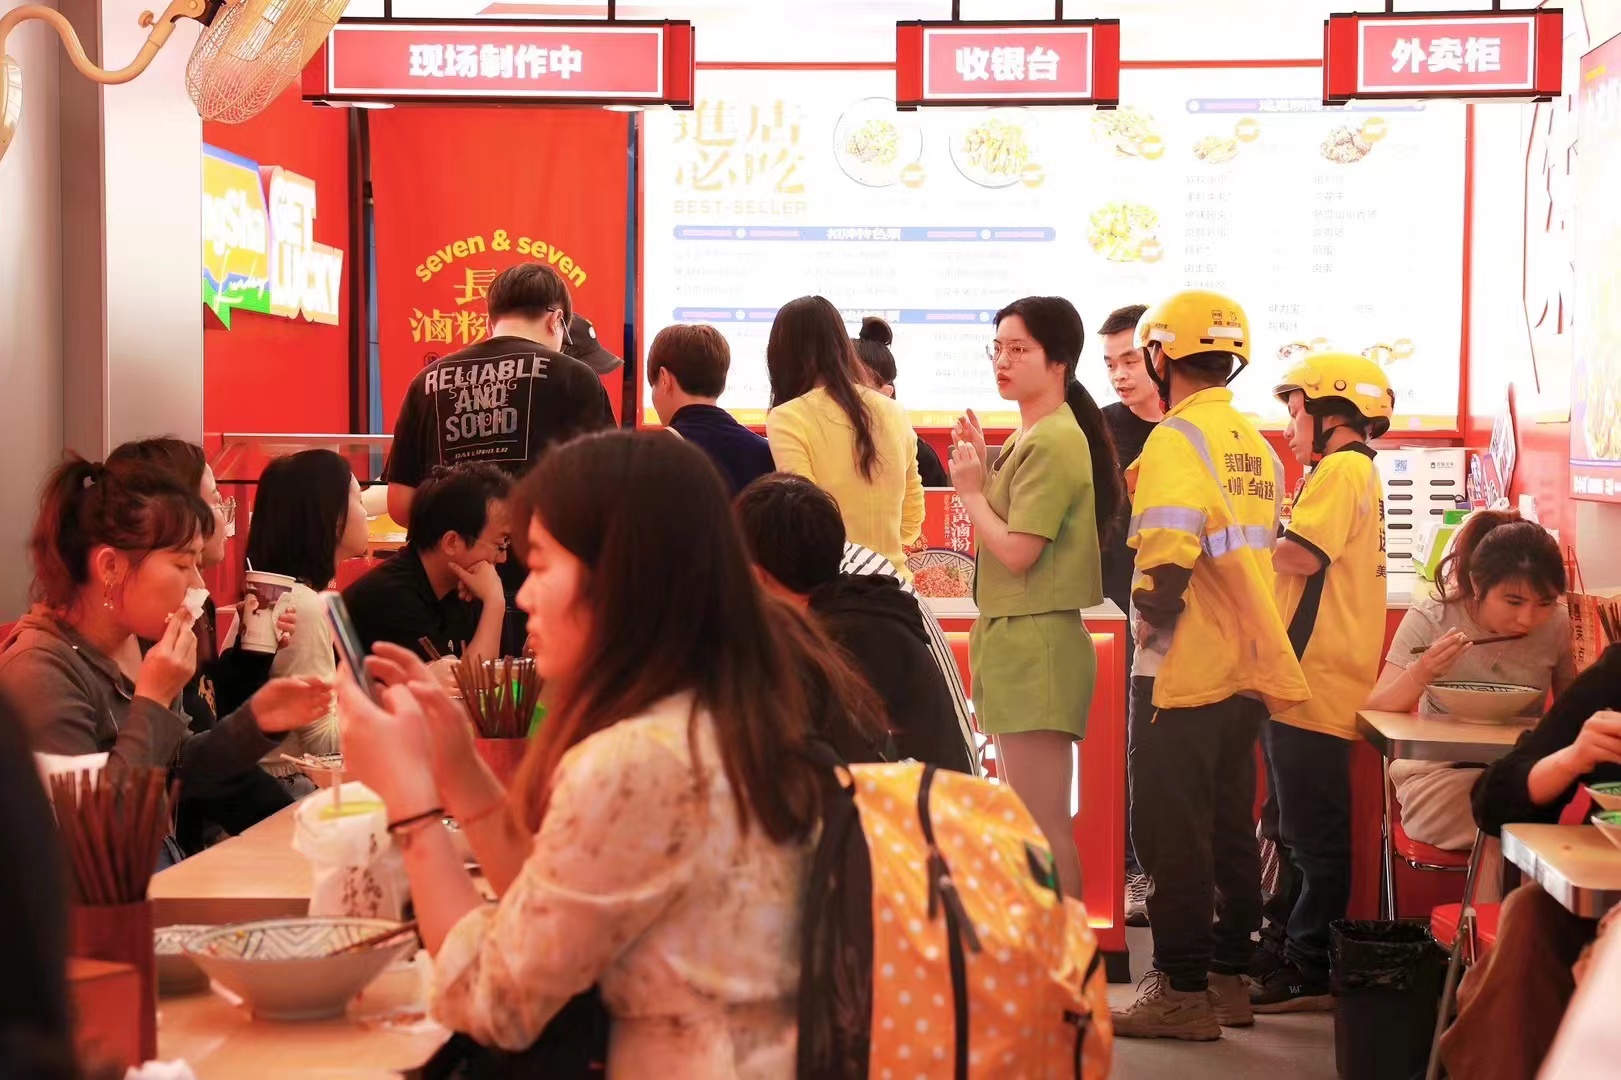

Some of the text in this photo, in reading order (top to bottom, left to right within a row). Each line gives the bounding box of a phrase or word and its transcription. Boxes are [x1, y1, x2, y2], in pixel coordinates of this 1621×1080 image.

[408, 43, 583, 79] 现场制作中
[955, 45, 1061, 81] 收银台
[1391, 37, 1501, 73] 外卖柜
[673, 199, 807, 215] BEST-SELLER
[415, 229, 587, 288] seven & seven
[453, 266, 498, 306] 長
[424, 356, 551, 396] RELIABLE
[454, 383, 508, 415] AND
[445, 407, 518, 442] SOLID
